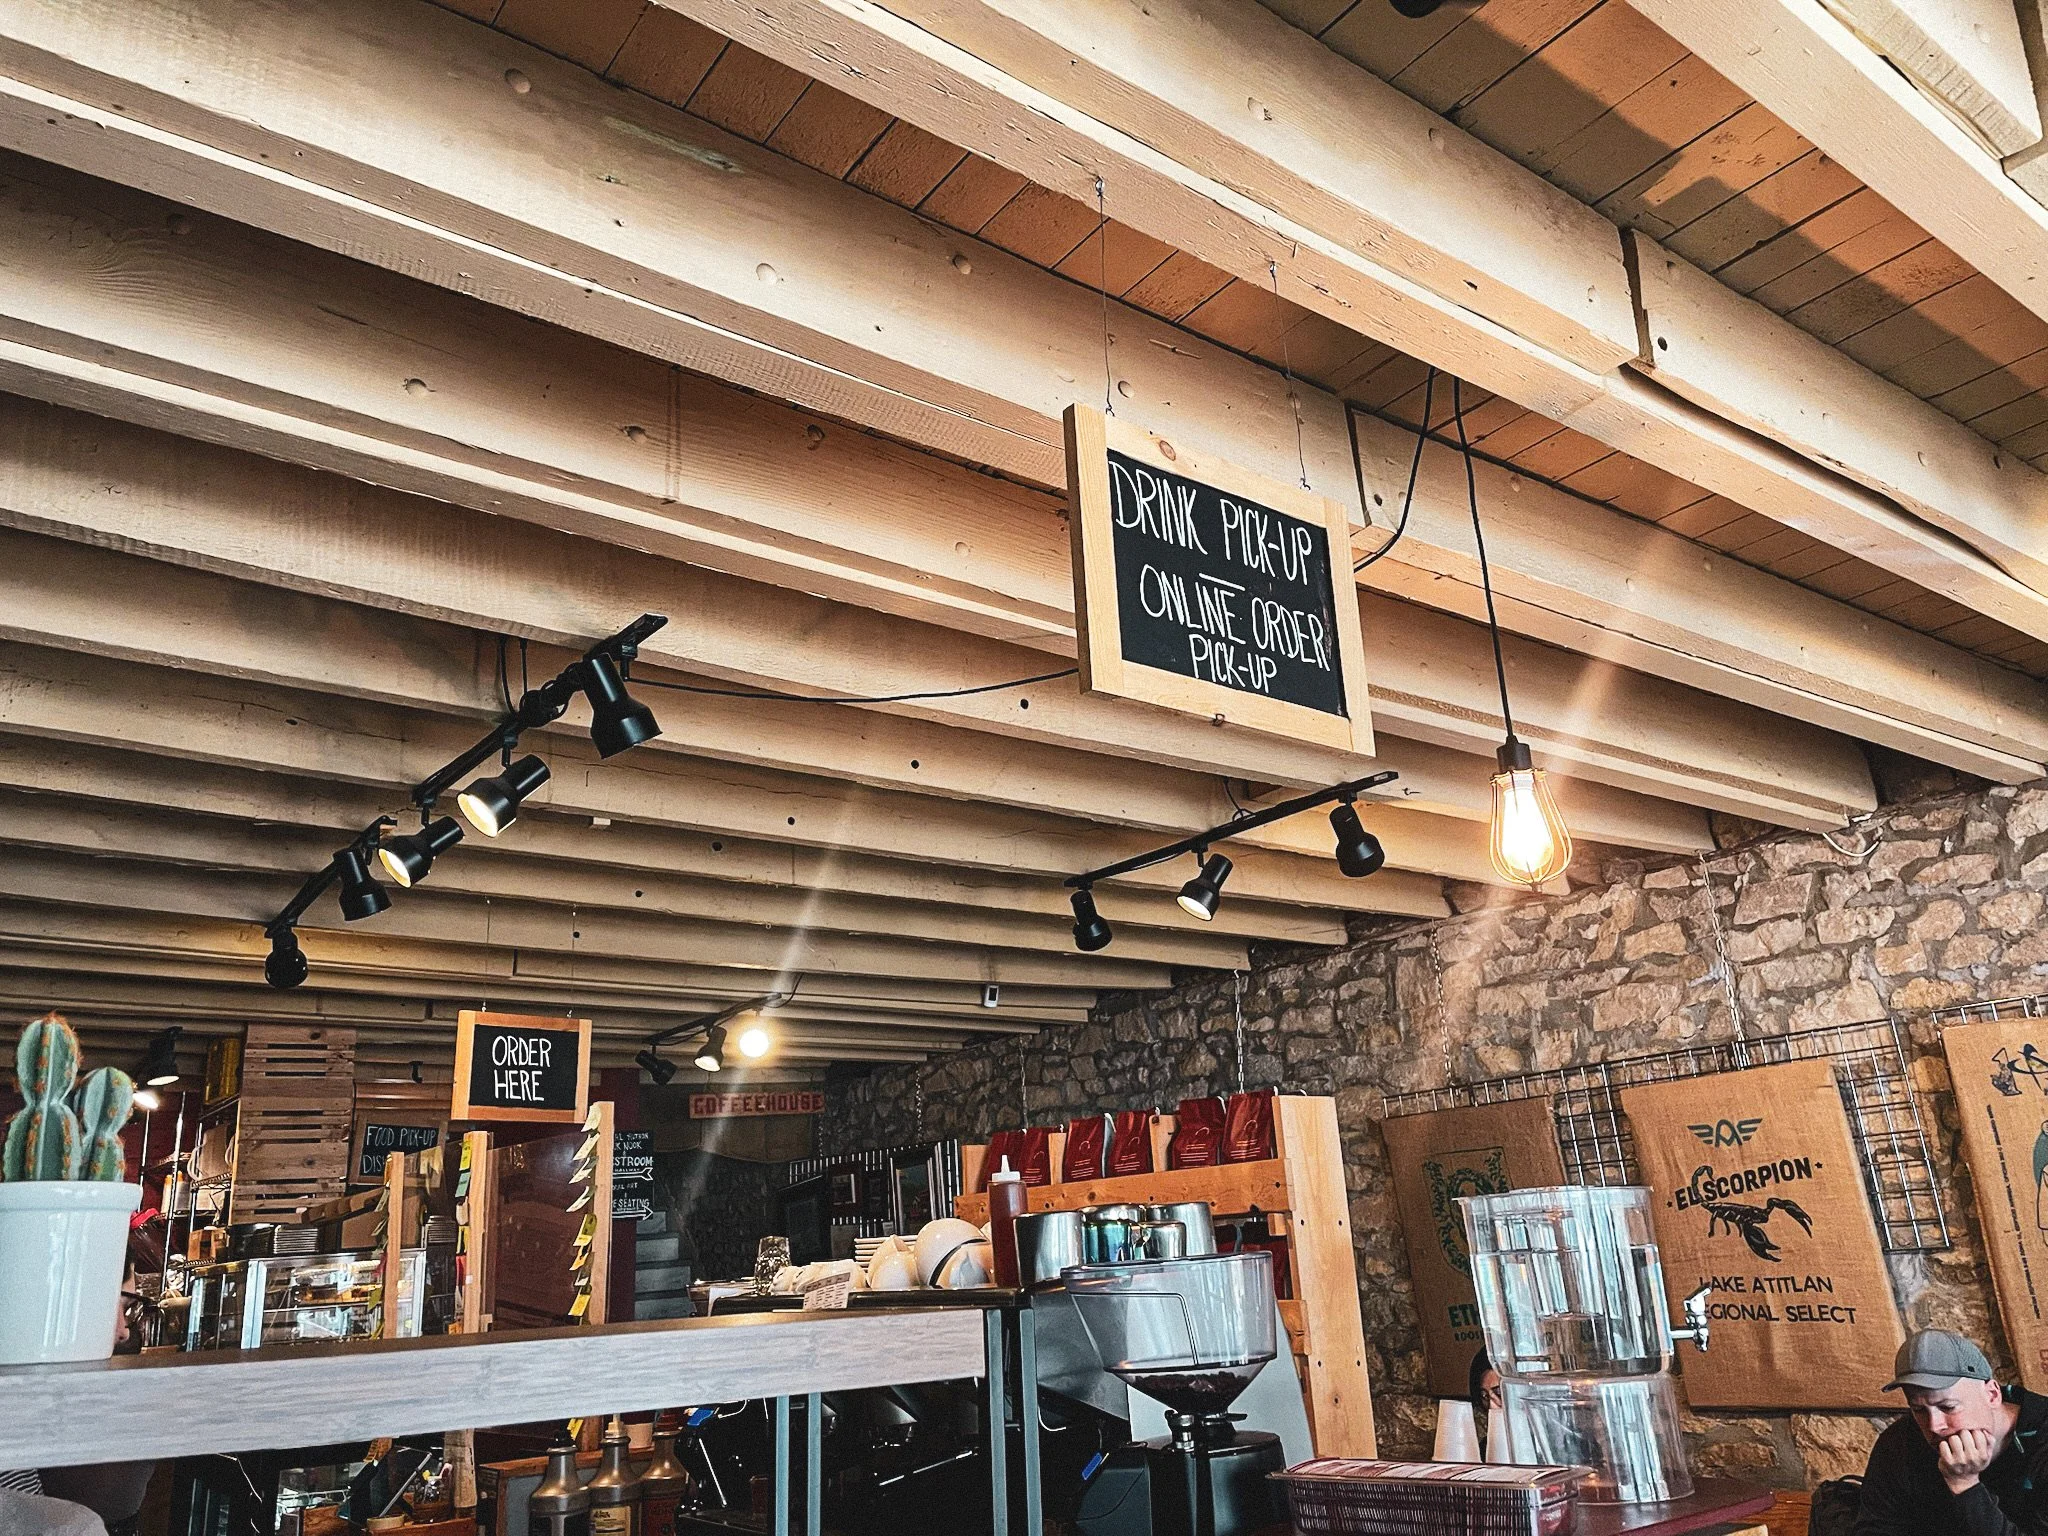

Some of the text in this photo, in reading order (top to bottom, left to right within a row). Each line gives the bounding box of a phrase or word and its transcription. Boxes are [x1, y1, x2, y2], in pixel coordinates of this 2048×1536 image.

[1108, 460, 1313, 586] DRINK PICK-UP
[1139, 563, 1331, 672] ONLINE ORDER
[1189, 633, 1277, 693] PICK-UP
[491, 1035, 552, 1068] ORDER
[493, 1069, 545, 1102] HERE
[694, 1094, 822, 1114] COFFEEHOUSE
[366, 1126, 436, 1147] FOOD PICK-UP
[613, 1156, 653, 1167] STROOM
[1702, 1157, 1813, 1201] SCORPION
[1752, 1275, 1834, 1294] ATITLAN
[1704, 1303, 1857, 1325] EGIONAL SELECT
